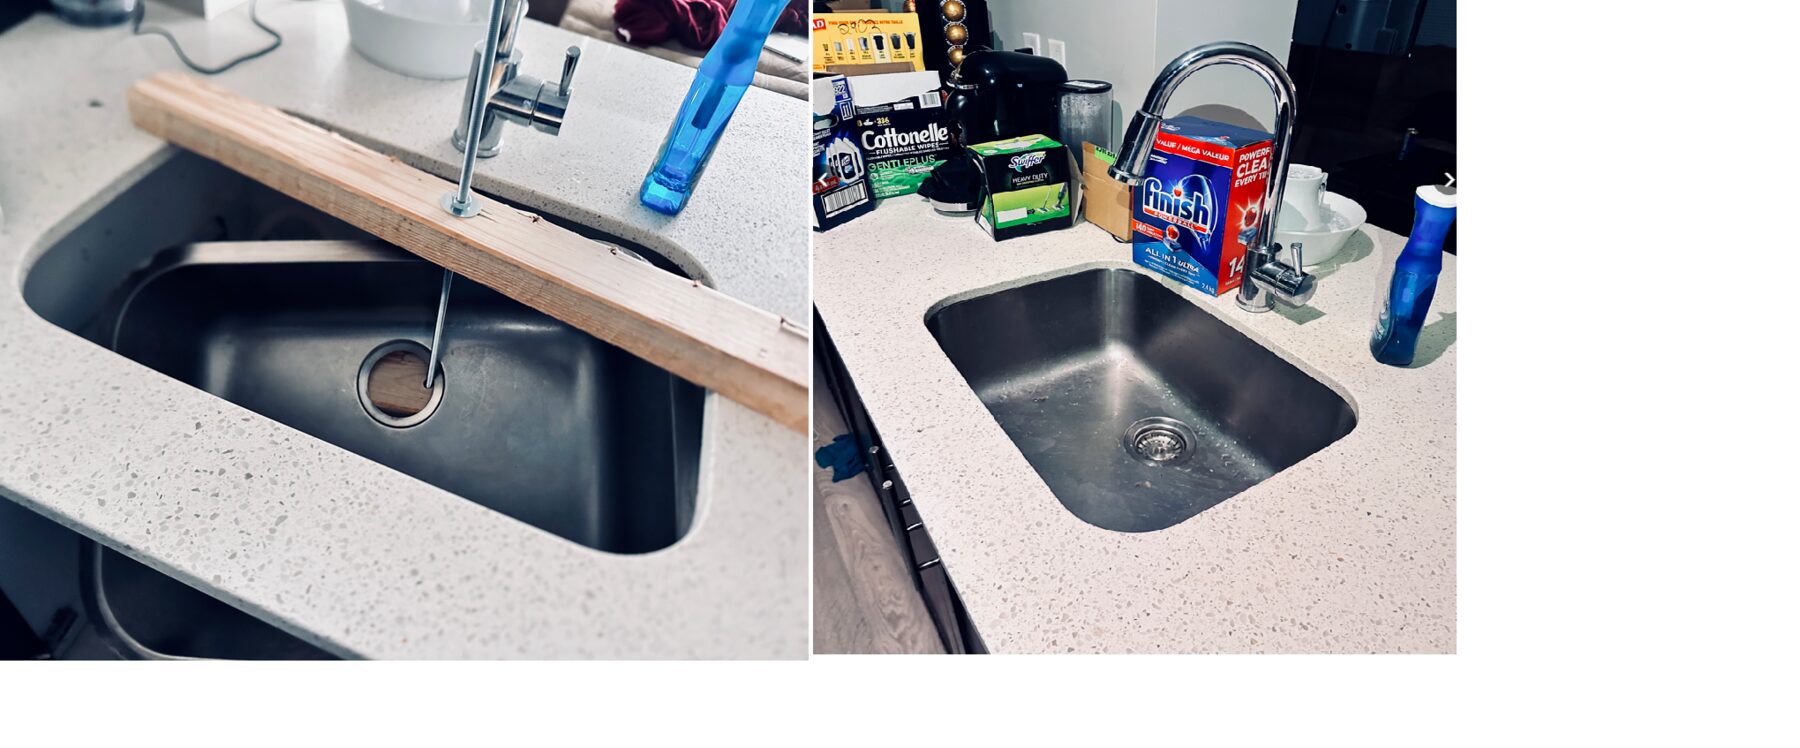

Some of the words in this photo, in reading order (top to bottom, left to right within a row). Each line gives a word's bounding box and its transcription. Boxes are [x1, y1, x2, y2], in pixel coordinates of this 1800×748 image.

[861, 122, 948, 150] Cottonelle
[875, 145, 916, 156] FLUSHABLE
[917, 142, 940, 150] WIPES
[1156, 138, 1176, 149] VALUE
[1203, 148, 1230, 161] VALEUR
[1239, 147, 1270, 163] POWERF
[1008, 152, 1047, 169] Swiffer
[1236, 157, 1268, 178] CLEA
[1012, 174, 1031, 183] HEAVY
[1032, 172, 1048, 181] DUTY
[1234, 173, 1258, 188] EVERY
[1143, 178, 1211, 228] finish
[1145, 247, 1161, 258] ALL
[1161, 254, 1171, 262] IN
[1172, 255, 1177, 264] 1
[1177, 260, 1200, 273] ULTRA
[1228, 254, 1246, 278] 14
